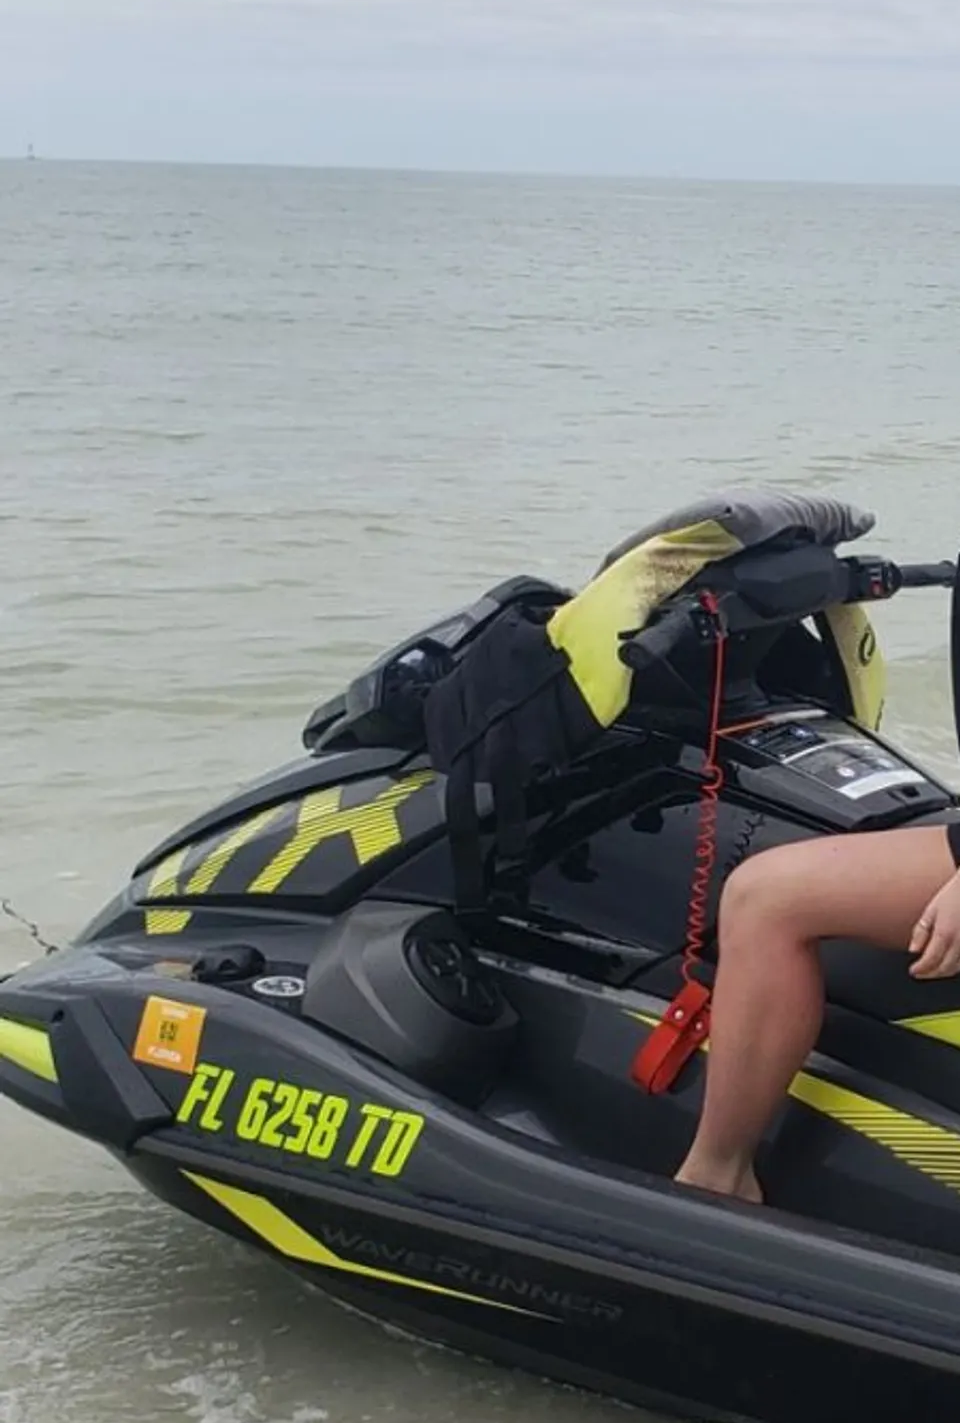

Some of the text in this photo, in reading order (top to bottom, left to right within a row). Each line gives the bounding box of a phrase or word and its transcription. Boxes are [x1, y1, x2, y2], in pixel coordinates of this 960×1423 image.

[176, 1063, 425, 1176] FL 6258 TD
[321, 1224, 624, 1318] WAVERUNNER
